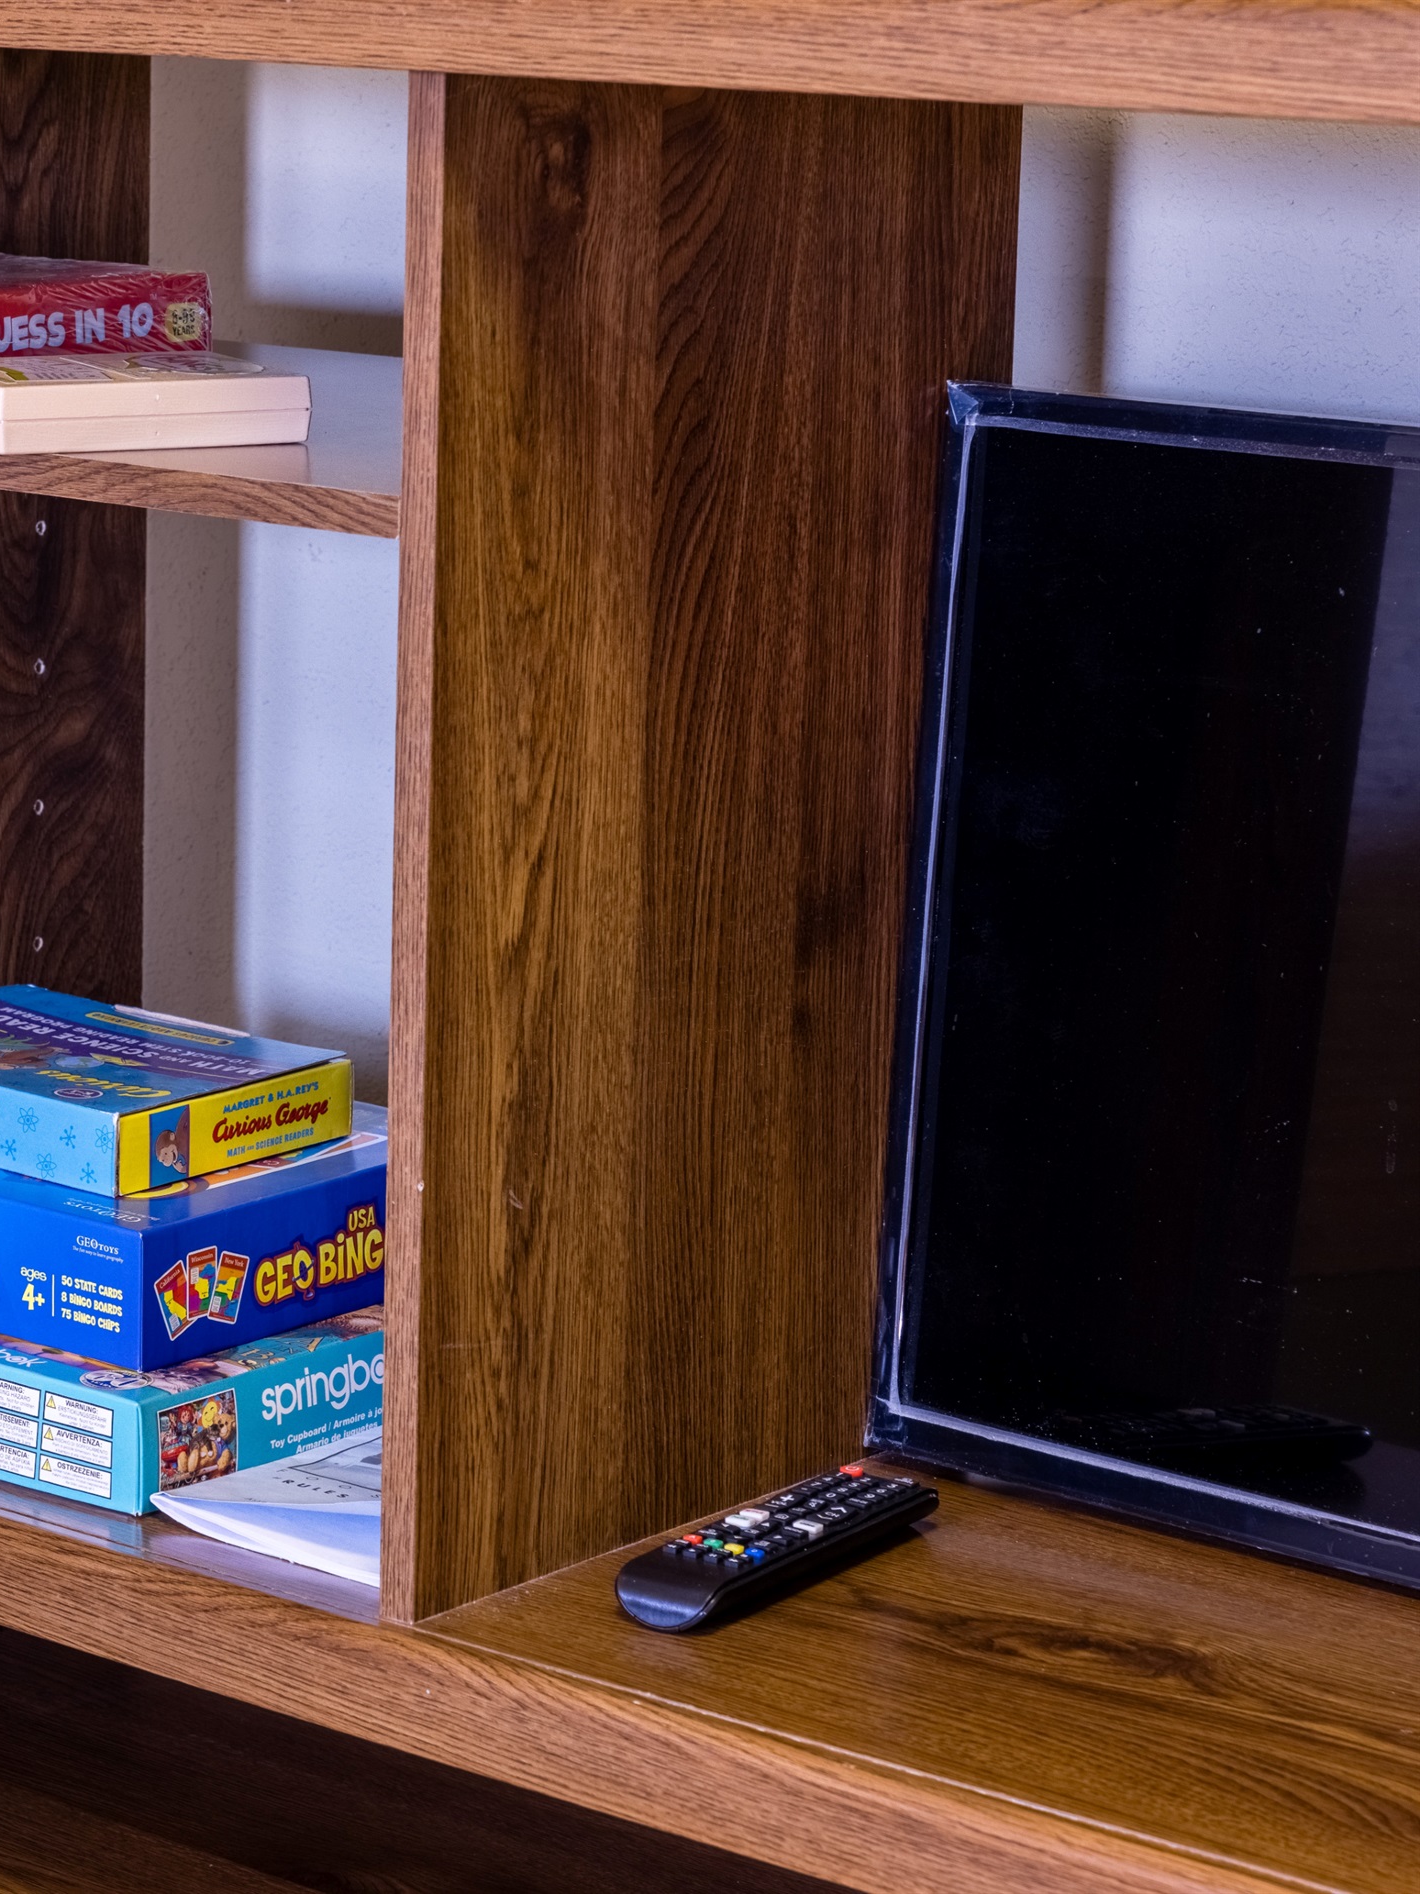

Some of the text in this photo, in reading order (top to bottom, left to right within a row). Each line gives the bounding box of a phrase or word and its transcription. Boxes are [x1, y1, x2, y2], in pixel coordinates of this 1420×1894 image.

[75, 307, 106, 344] IN
[118, 302, 154, 337] 10
[0, 1007, 74, 1030] PROGRAM
[55, 1032, 160, 1059] SCIENCE
[73, 1025, 139, 1044] READING
[188, 1059, 266, 1076] MATH
[223, 1095, 265, 1114] MARGRET
[268, 1093, 274, 1102] &
[212, 1099, 328, 1143] Curious George
[227, 1127, 314, 1158] MATH SCIENCE READERS
[349, 1206, 375, 1231] USA
[191, 1252, 213, 1264] Wisconsin
[224, 1256, 244, 1268] New York
[20, 1266, 47, 1282] ages
[159, 1269, 180, 1289] California
[256, 1250, 314, 1303] GEO
[22, 1283, 46, 1311] 4+
[61, 1275, 123, 1301] 50 STATE CARDS
[61, 1292, 67, 1302] 8
[94, 1300, 123, 1317] BOARDS
[61, 1308, 72, 1320] 75
[65, 1399, 98, 1414] WARNUNG:
[56, 1430, 102, 1448] AVVERTENZA:
[270, 1439, 285, 1449] Toy
[287, 1423, 327, 1444] Cupboard
[333, 1413, 366, 1430] Armoire
[367, 1409, 373, 1418] à
[296, 1437, 329, 1454] Armario
[331, 1433, 341, 1443] de
